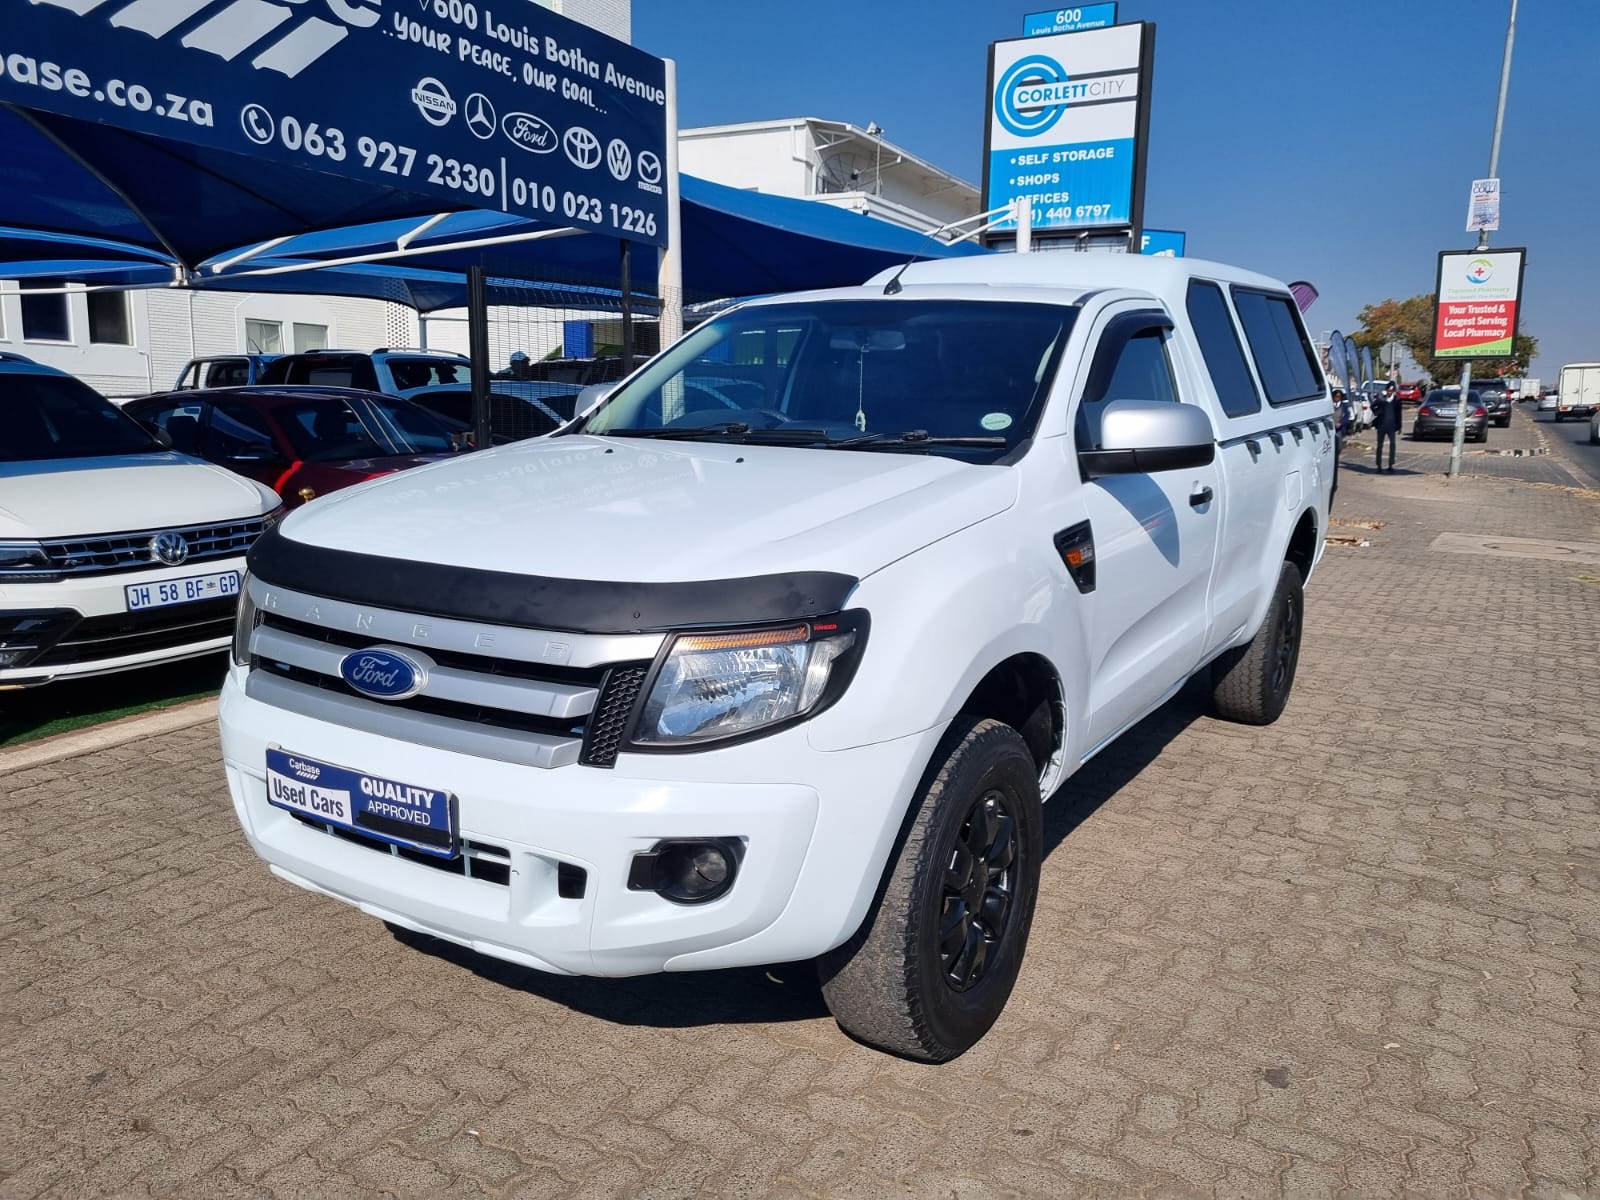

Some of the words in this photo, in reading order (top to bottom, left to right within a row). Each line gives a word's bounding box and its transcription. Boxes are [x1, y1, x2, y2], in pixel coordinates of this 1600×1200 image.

[1031, 26, 1051, 35] Louis
[1053, 24, 1075, 32] Botha
[1076, 20, 1105, 29] Avenue
[1056, 8, 1081, 24] 600
[434, 0, 478, 30] 600
[485, 10, 539, 55] Louis
[545, 36, 600, 79] Botha
[604, 62, 665, 105] Avenue
[0, 53, 214, 127] ase.co.za
[523, 62, 557, 92] OUR
[414, 92, 454, 111] NISSAN
[513, 118, 548, 147] Ford
[281, 115, 346, 161] 063
[358, 136, 417, 177] 927
[426, 154, 495, 197] 2330
[1018, 153, 1049, 166] SELF
[1053, 147, 1114, 163] STORAGE
[1017, 173, 1060, 186] SHOPS
[512, 178, 556, 213] 010
[562, 191, 603, 224] 023
[610, 203, 657, 236] 1226
[1046, 207, 1072, 218] 440
[1075, 204, 1111, 217] 6797
[1444, 317, 1476, 327] Longest
[1477, 316, 1508, 327] Serving
[1449, 305, 1466, 314] Your
[1468, 304, 1497, 314] Trusted
[1499, 304, 1506, 313] &
[1443, 329, 1465, 338] Local
[1466, 328, 1506, 338] Pharmacy
[131, 587, 150, 607] JH
[159, 584, 179, 603] 58
[186, 580, 203, 599] BF
[219, 575, 236, 593] GP
[264, 591, 572, 660] RANGER
[353, 656, 399, 687] Ford
[289, 758, 320, 776] Carbase
[273, 777, 306, 807] Used
[310, 790, 344, 818] Cars
[360, 777, 434, 809] QUALITY
[368, 800, 431, 826] APPROVED
